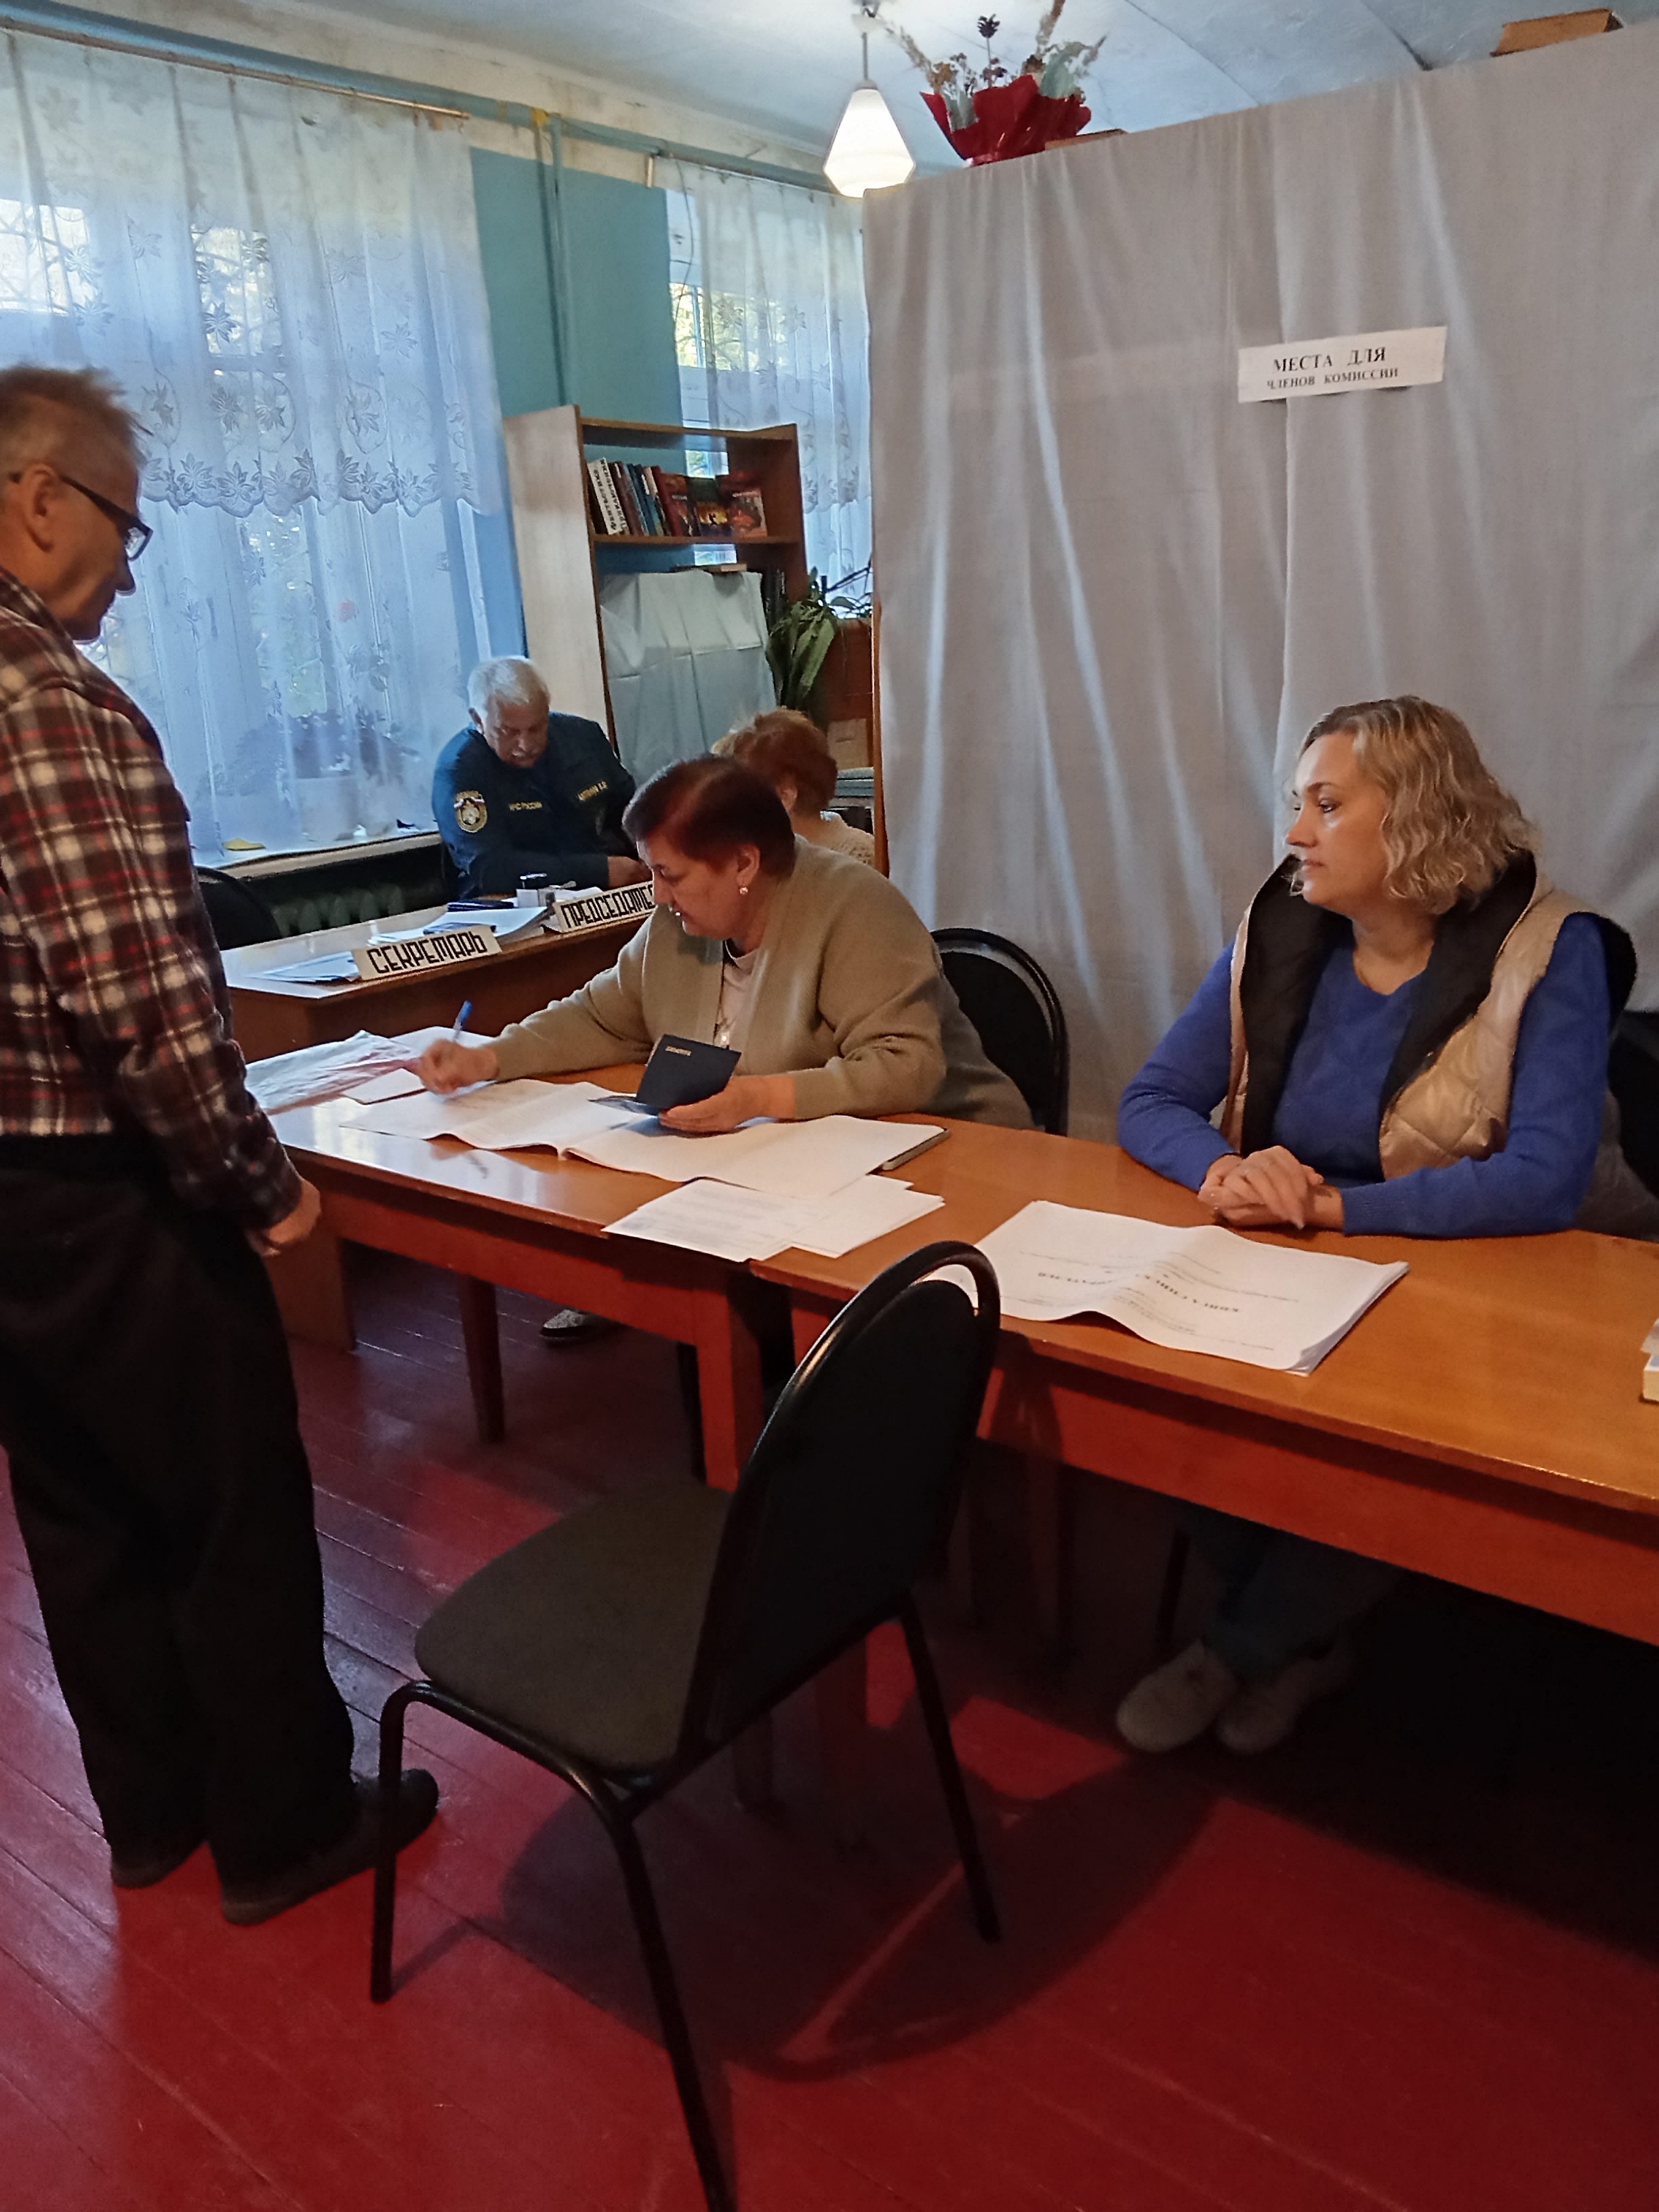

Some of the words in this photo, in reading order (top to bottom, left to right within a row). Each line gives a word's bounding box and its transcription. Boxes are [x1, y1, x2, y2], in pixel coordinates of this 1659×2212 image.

[1273, 354, 1332, 372] МЕСТА
[1347, 347, 1386, 366] ДЛЯ
[1267, 375, 1315, 390] ЧЛЕНОВ
[1324, 367, 1398, 384] КОМИССИИ
[560, 884, 656, 928] ПРЕДСЕДАТЕ
[367, 930, 488, 974] СЕКРЕТАРЬ
